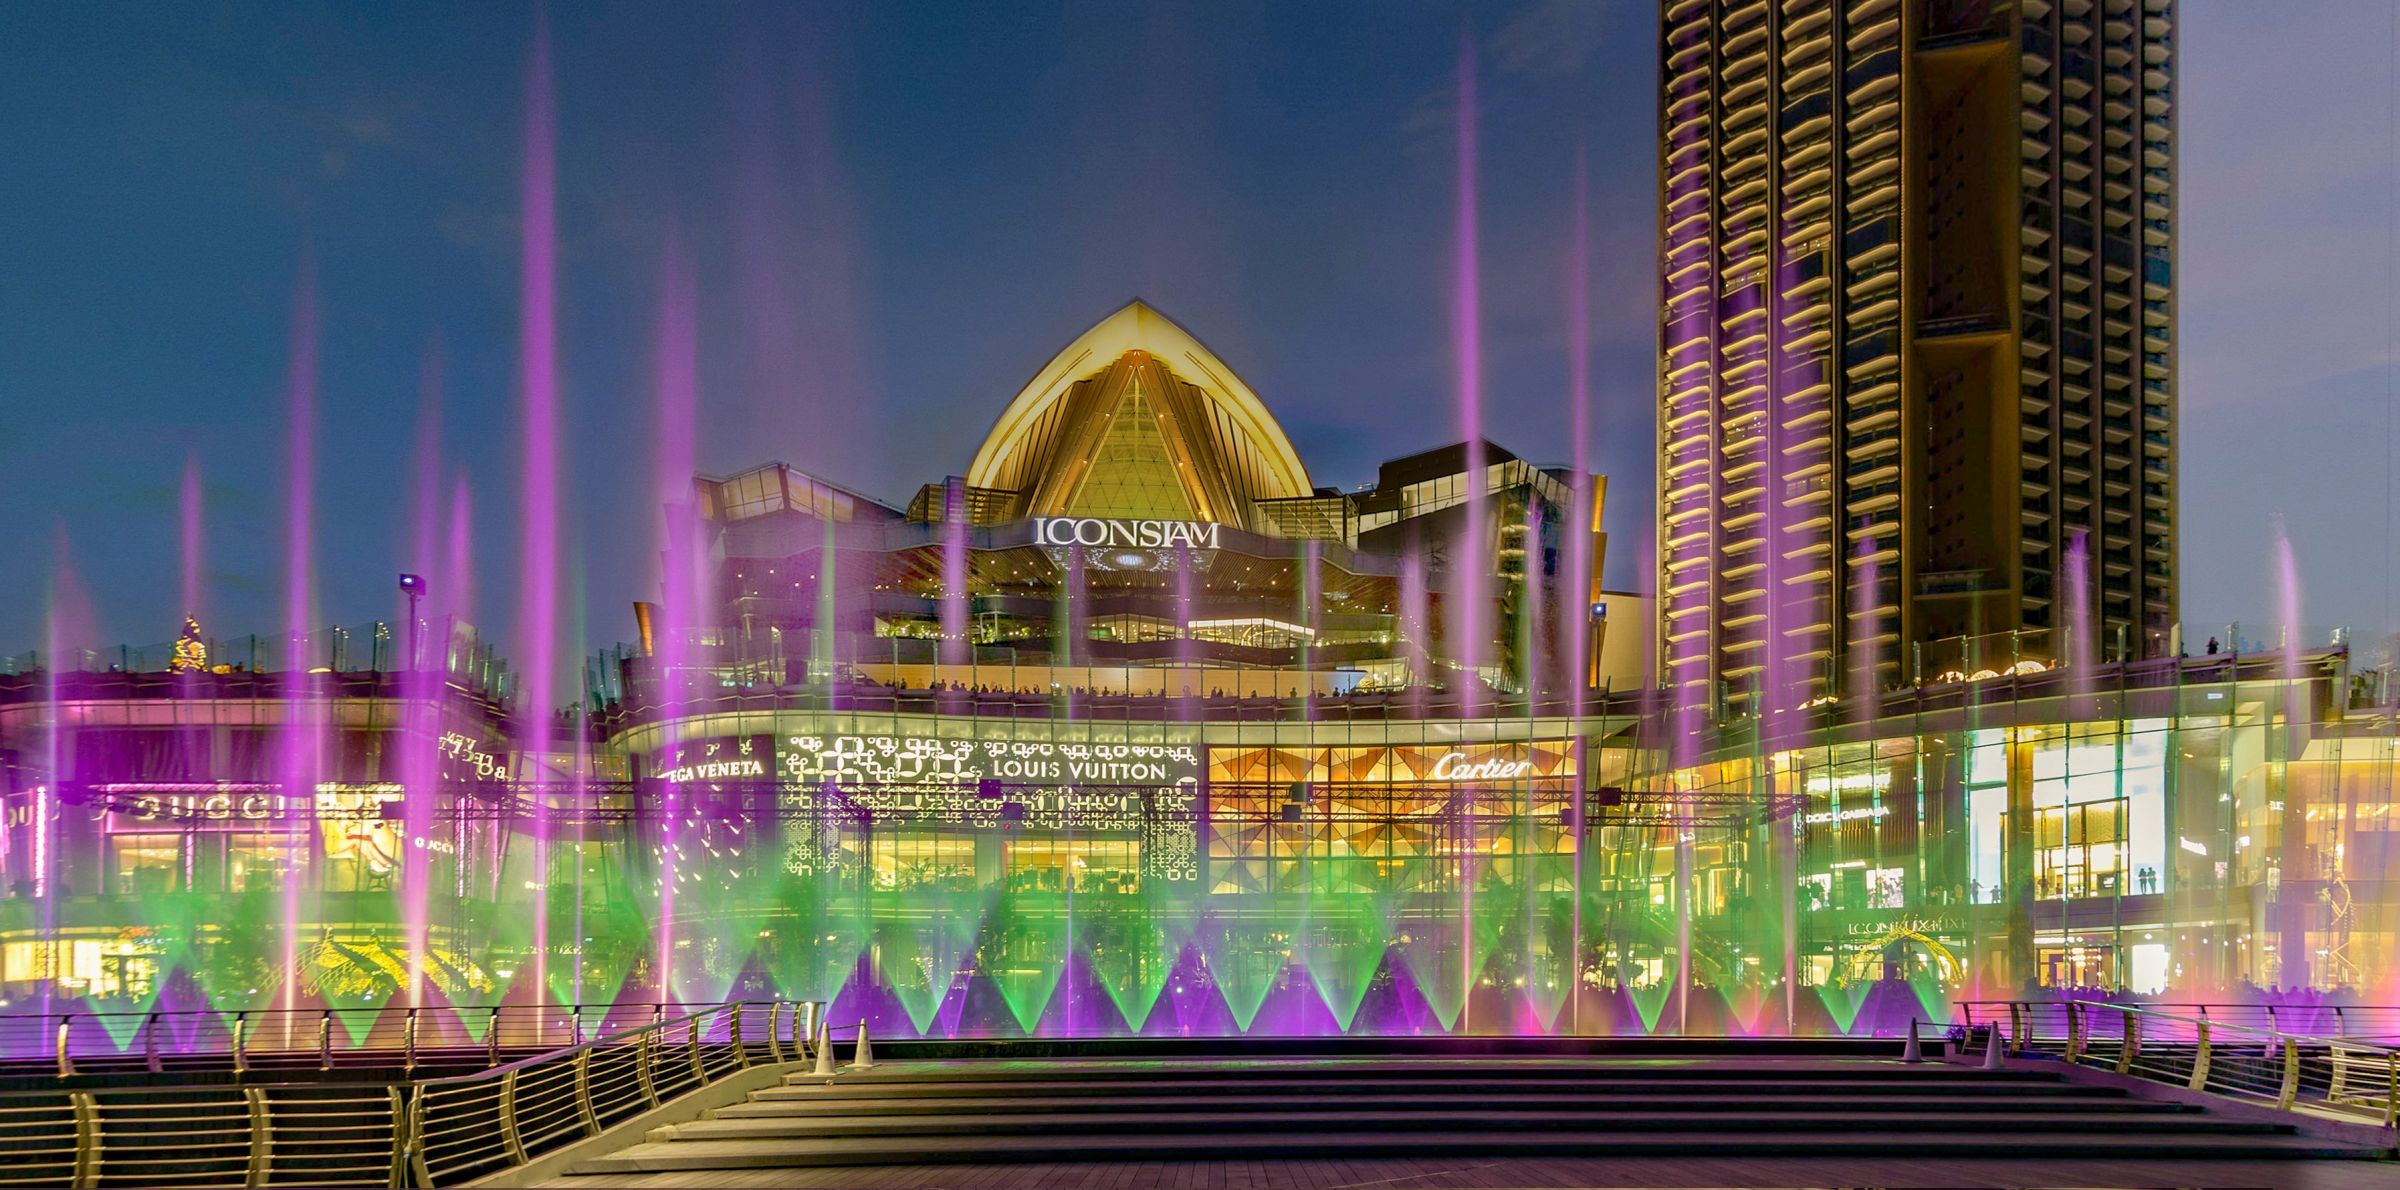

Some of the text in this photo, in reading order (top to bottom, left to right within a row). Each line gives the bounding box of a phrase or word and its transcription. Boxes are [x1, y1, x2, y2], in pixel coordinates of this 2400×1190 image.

[1034, 518, 1221, 548] ICONSIAM
[696, 760, 763, 778] VENETA
[993, 760, 1166, 779] LOUIS VUITTON
[1434, 752, 1531, 780] Cartier
